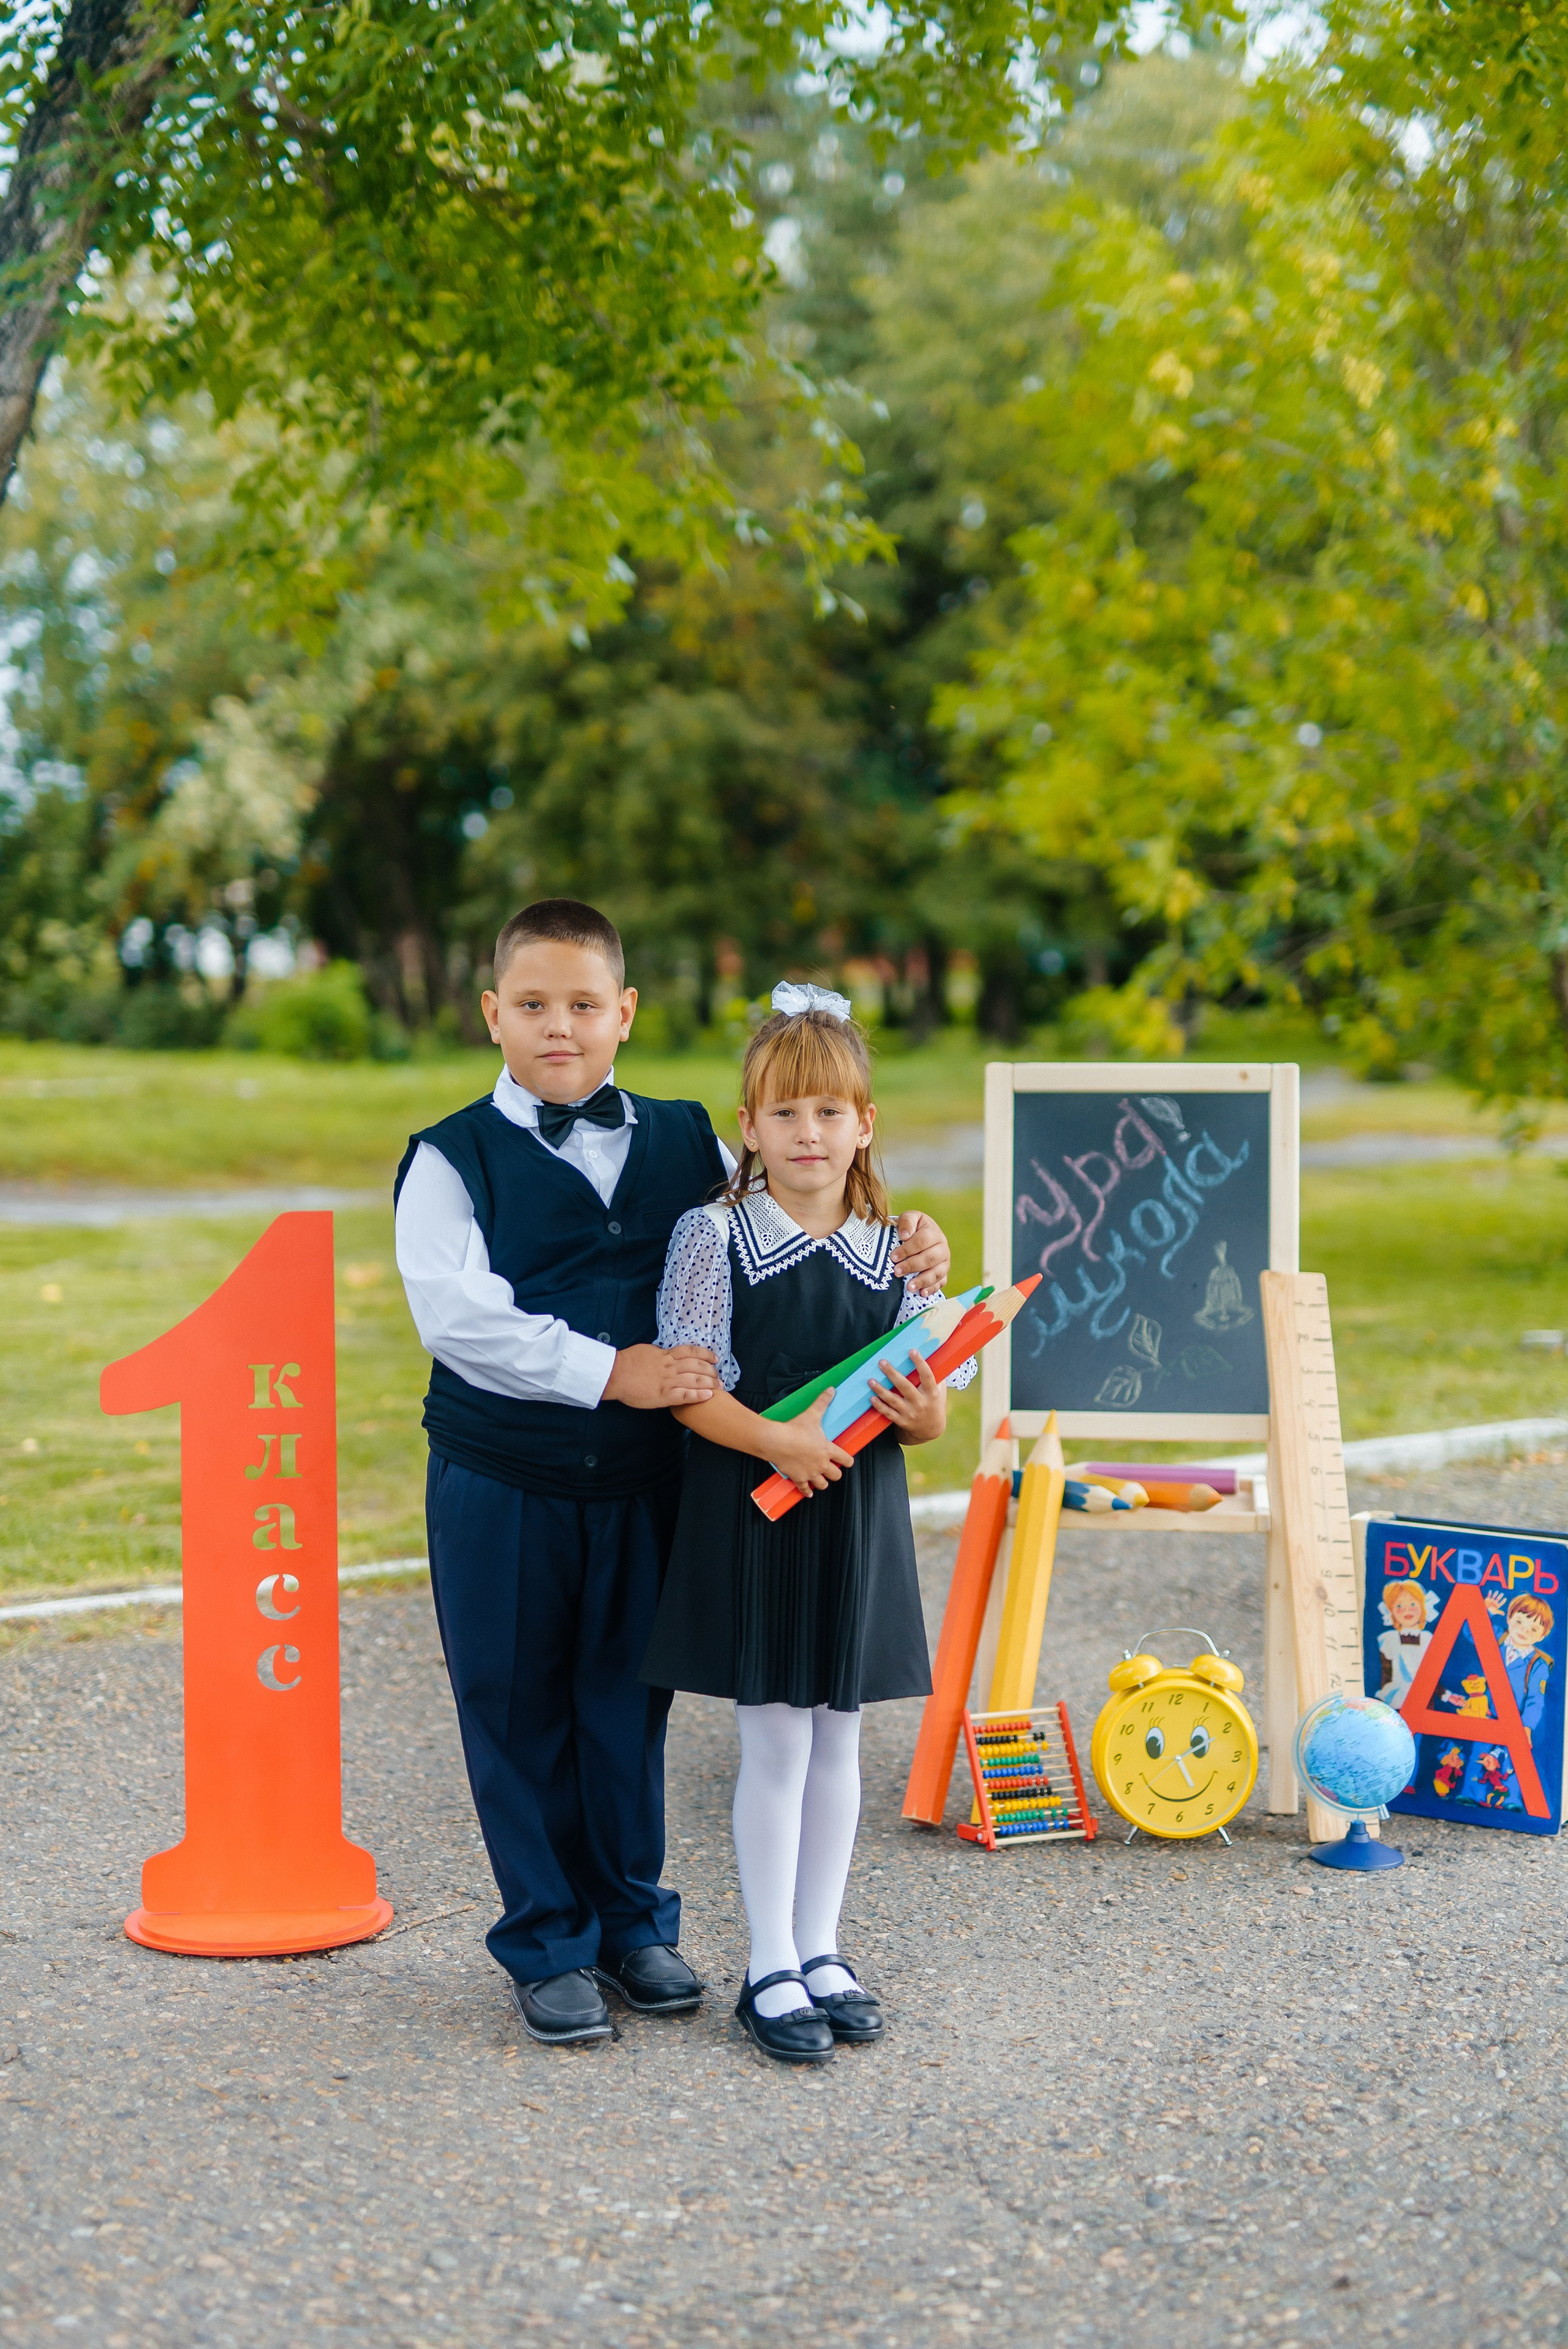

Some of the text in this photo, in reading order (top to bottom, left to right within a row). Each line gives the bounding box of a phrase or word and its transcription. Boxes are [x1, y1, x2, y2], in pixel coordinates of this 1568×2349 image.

[244, 1362, 304, 1692] класс
[1383, 1541, 1559, 1594] БУКВАРЬ
[1169, 1694, 1184, 1705] 12
[1141, 1702, 1155, 1713] 11
[1203, 1702, 1209, 1713] 1
[1120, 1724, 1135, 1735] 10
[1223, 1722, 1232, 1733] 2
[1114, 1754, 1122, 1765] 9
[1232, 1751, 1242, 1762] 3
[1125, 1782, 1134, 1794] 8
[1227, 1781, 1236, 1793] 4
[1147, 1803, 1155, 1815] 7
[1205, 1803, 1214, 1815] 5
[1176, 1811, 1183, 1823] 6
